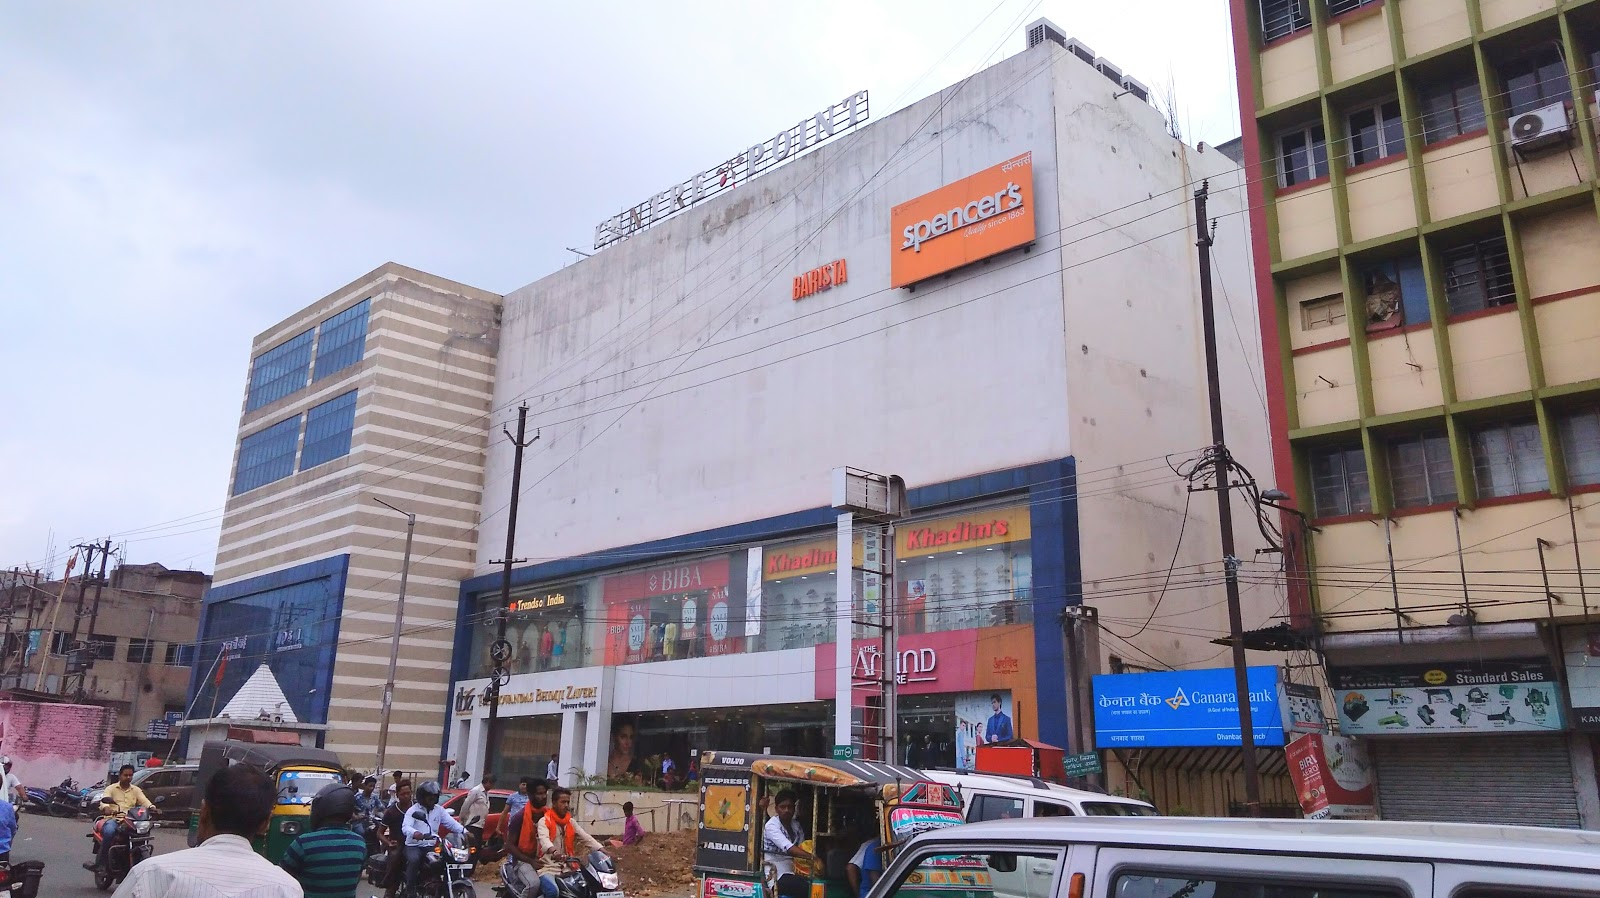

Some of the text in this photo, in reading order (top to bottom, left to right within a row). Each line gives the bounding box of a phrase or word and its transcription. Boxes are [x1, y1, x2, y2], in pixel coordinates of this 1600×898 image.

[748, 90, 864, 176] POINT
[903, 181, 1023, 253] spencer's
[988, 216, 1007, 229] since
[1008, 206, 1025, 220] 1863
[792, 258, 848, 302] BARISTA
[907, 519, 1009, 550] Khadim's
[767, 548, 838, 574] Khadim
[662, 565, 702, 592] BIBA
[517, 597, 539, 611] Trends
[546, 593, 565, 606] India
[864, 645, 877, 653] THE
[1456, 671, 1508, 684] Standard
[1511, 670, 1544, 682] Sales
[1099, 692, 1162, 708] केनरा बैंक
[1191, 691, 1236, 704] Canara
[1248, 688, 1273, 702] ank
[721, 757, 745, 765] VOLVO
[704, 777, 749, 785] EXPRESS
